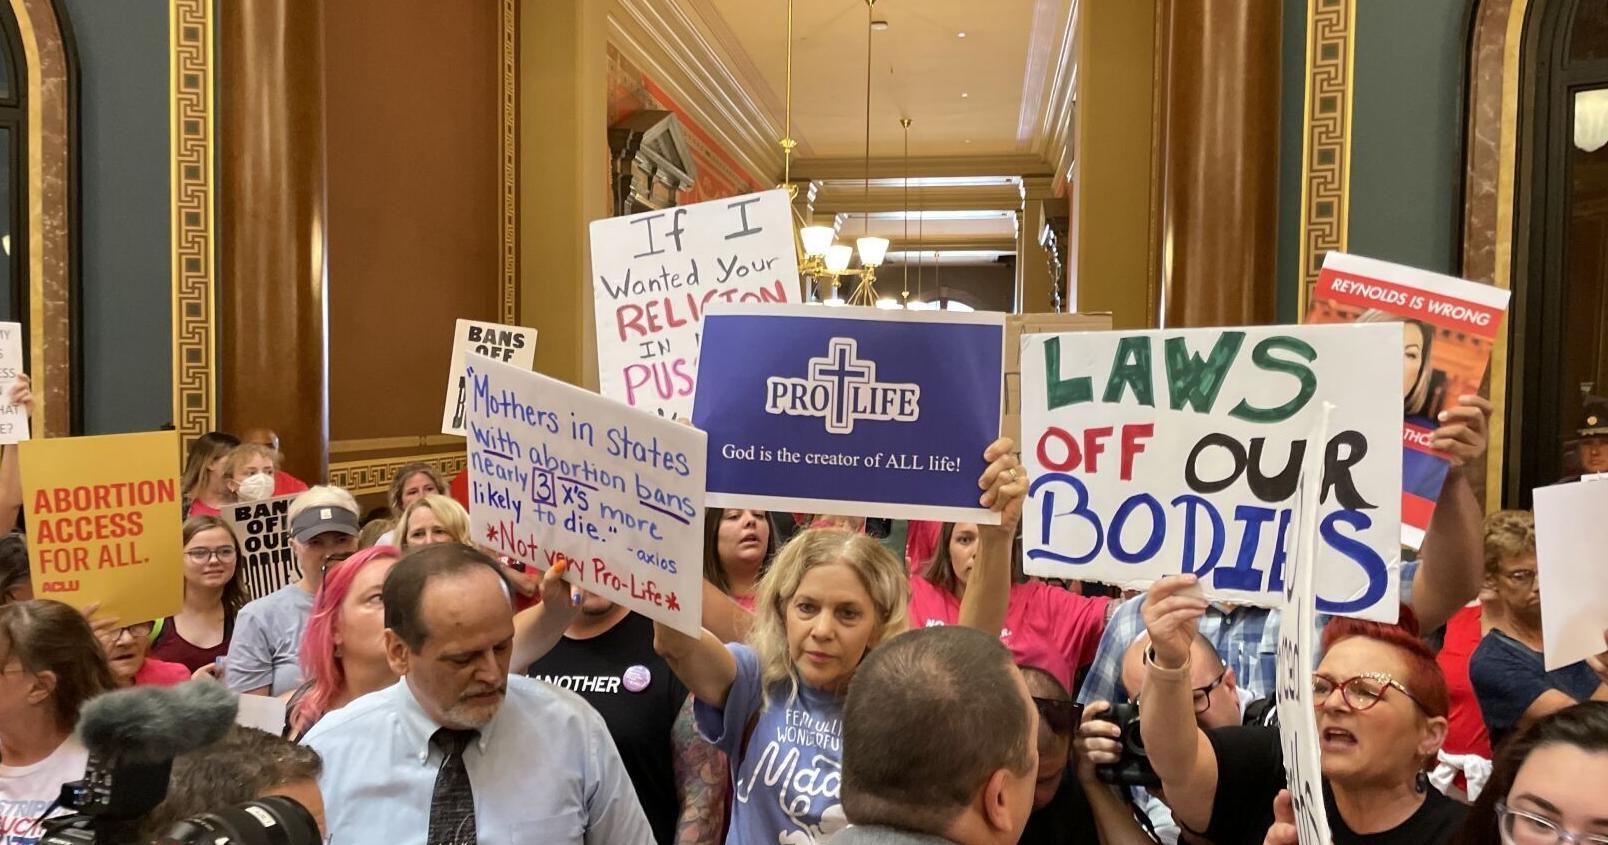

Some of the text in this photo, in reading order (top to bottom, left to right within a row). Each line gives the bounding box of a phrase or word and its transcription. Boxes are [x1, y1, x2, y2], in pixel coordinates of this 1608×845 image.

[630, 197, 763, 259] If I
[600, 258, 699, 299] Wanted
[1331, 277, 1491, 327] REYNOLDS IS WRONG
[468, 325, 525, 349] BANS
[639, 337, 671, 360] IN
[622, 357, 699, 407] PUS
[1043, 331, 1318, 424] LAWS
[771, 381, 917, 418] PRO LIFE
[570, 412, 594, 447] in
[722, 443, 961, 473] God is the creator of ALL life!
[1036, 422, 1380, 510] OFF OUR
[34, 478, 175, 514] ABORTION
[471, 450, 528, 492] nearly
[600, 501, 664, 541] more
[529, 443, 626, 493] abortion
[635, 473, 697, 519] bans
[235, 498, 294, 522] BAN
[473, 481, 522, 523] likely
[532, 503, 556, 526] to
[37, 511, 144, 545] ACCESS
[39, 541, 150, 574] FOR ALL.
[42, 580, 80, 593] ACLU
